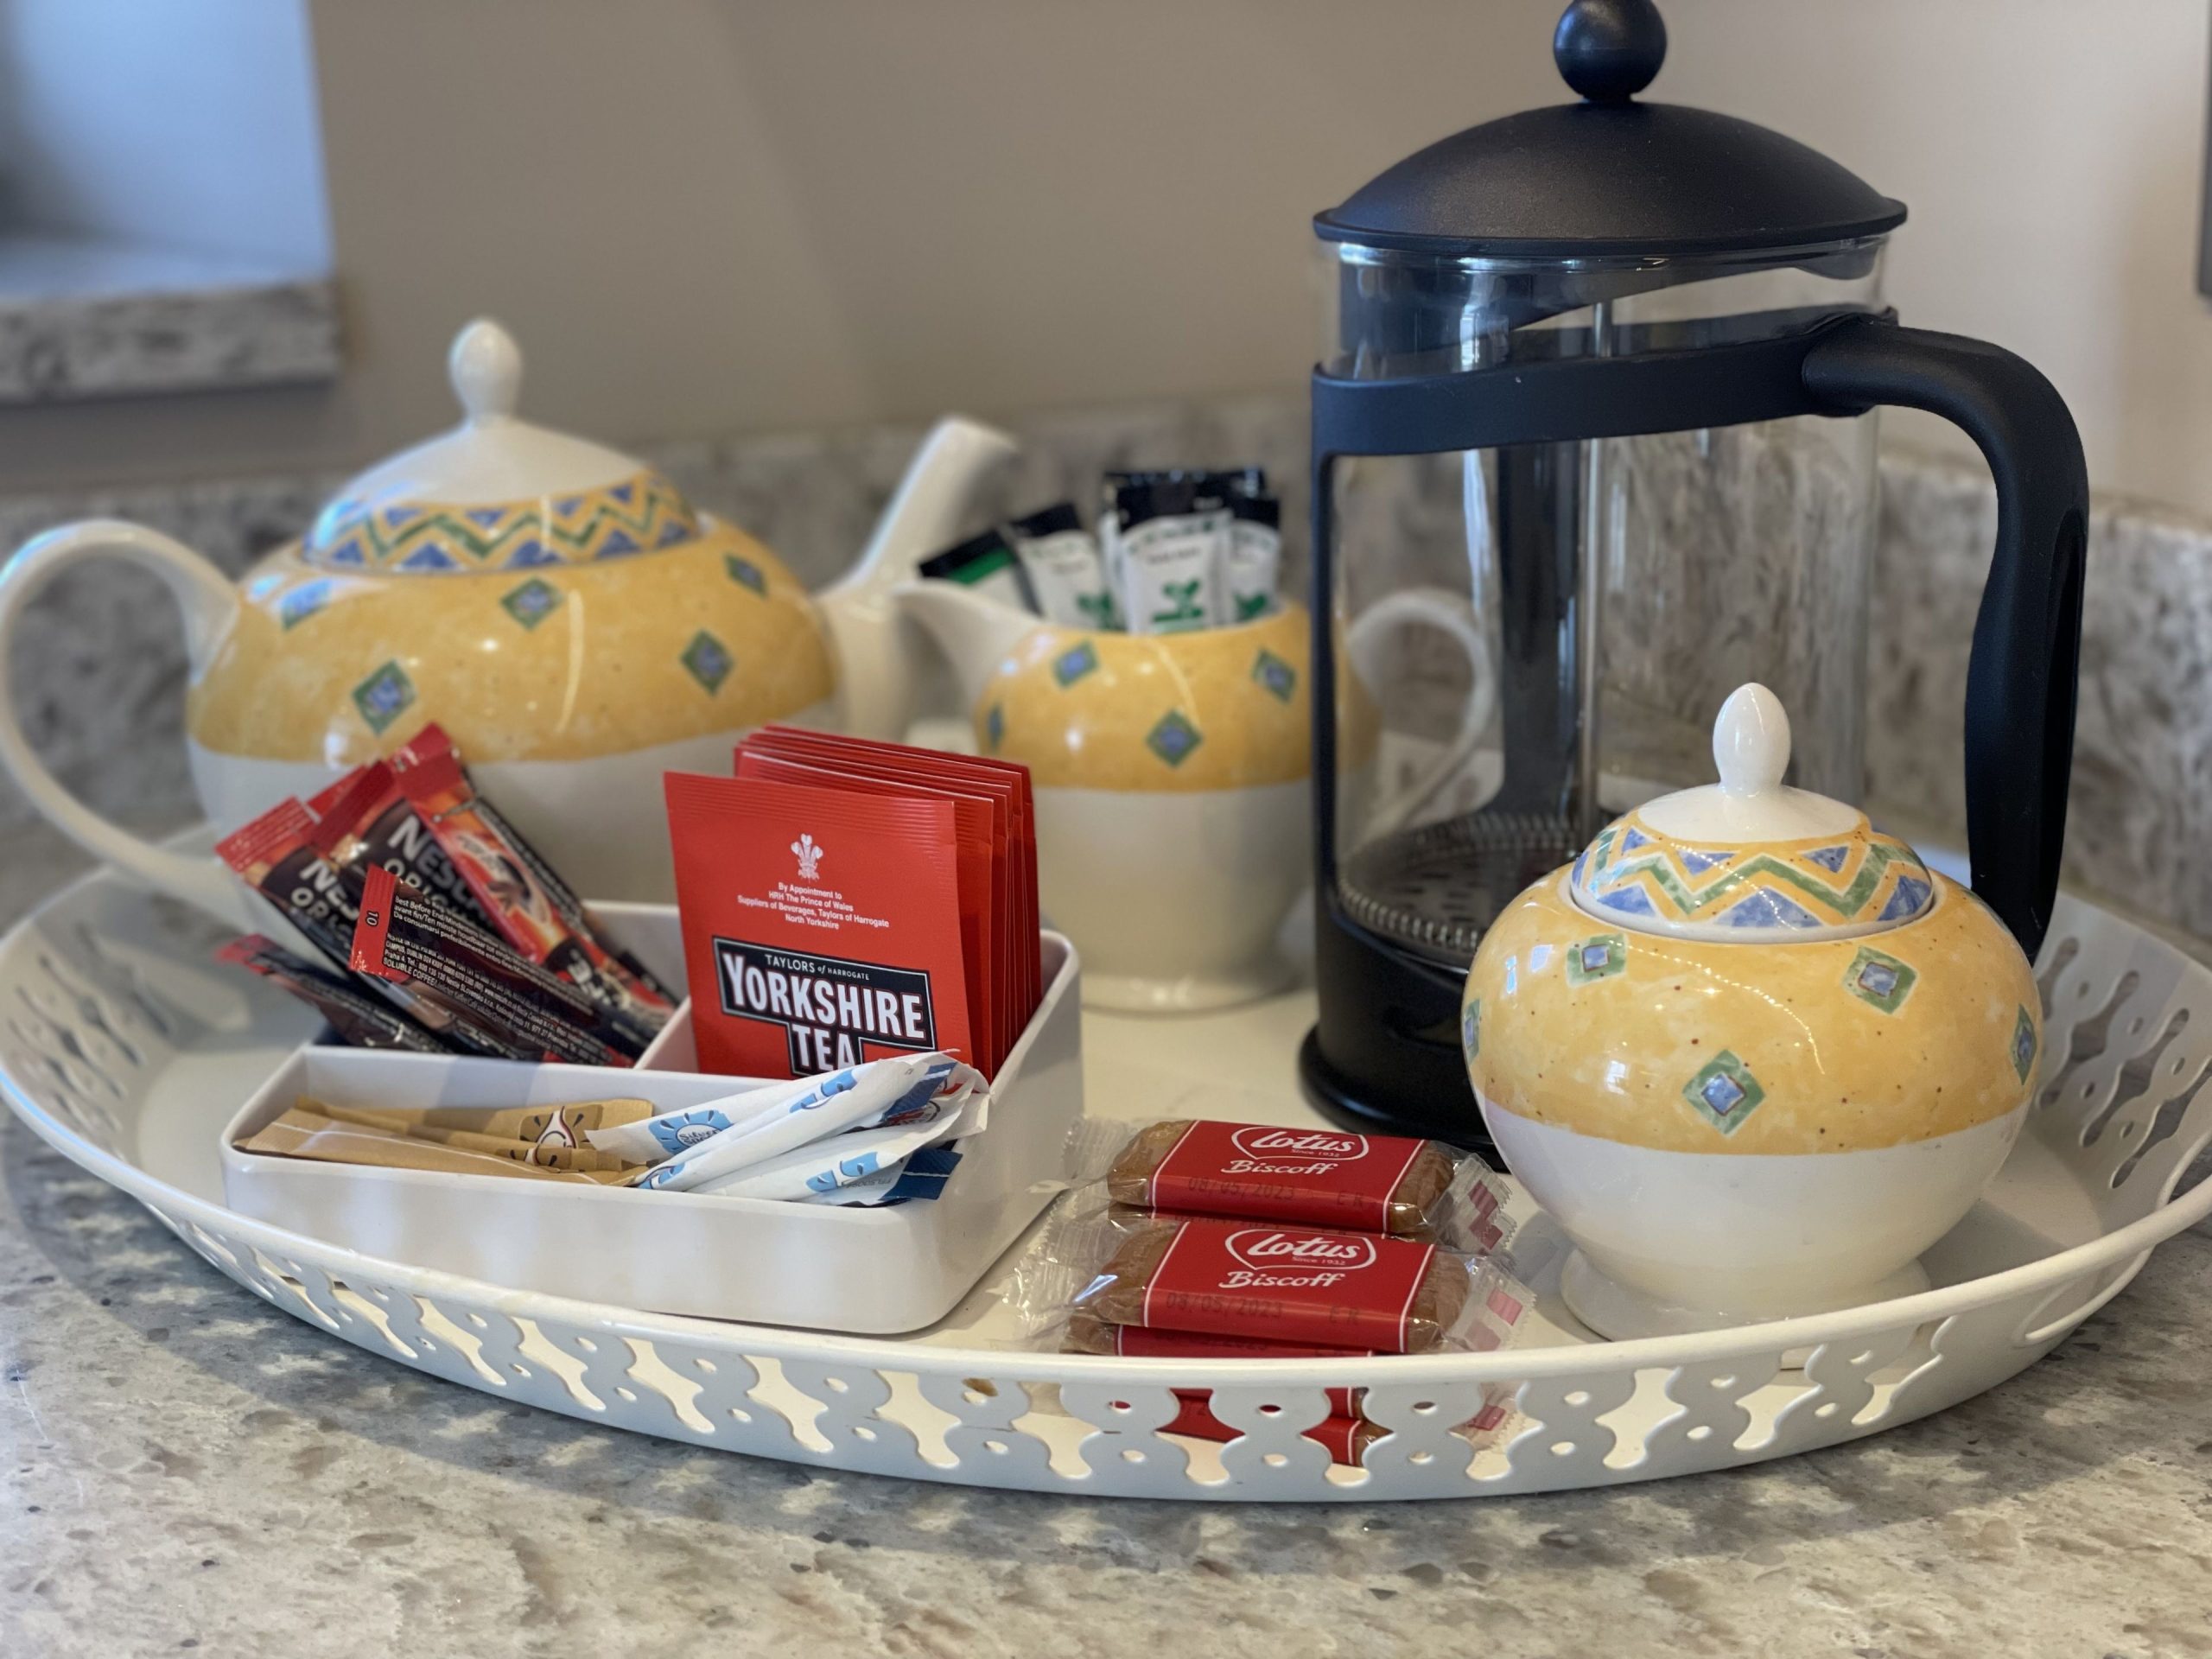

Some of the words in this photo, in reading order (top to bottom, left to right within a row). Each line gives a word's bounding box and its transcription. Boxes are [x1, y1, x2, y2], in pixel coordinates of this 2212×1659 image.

[779, 881, 788, 893] By
[789, 884, 834, 899] Appointment
[835, 892, 842, 900] to
[395, 895, 410, 907] Best
[410, 899, 431, 913] Before
[768, 890, 785, 900] HRH
[785, 893, 799, 904] The
[800, 895, 823, 906] Prince
[823, 899, 832, 908] of
[832, 901, 854, 912] Wales
[393, 906, 413, 917] avant
[737, 895, 769, 908] Suppliers
[770, 901, 778, 910] of
[818, 908, 844, 921] Taylors
[845, 912, 854, 922] of
[854, 914, 890, 929] Harrogate
[393, 911, 403, 920] Da
[404, 916, 440, 935] consumarsi
[785, 913, 804, 925] North
[806, 917, 840, 931] Yorkshire
[385, 949, 400, 962] Praha
[383, 957, 413, 975] SOLUBLE
[765, 953, 815, 974] TAYLORS
[817, 964, 827, 975] of
[827, 967, 870, 982] HARROGATE
[721, 952, 925, 1039] YORKSHIRE
[791, 1022, 856, 1071] TEA
[1250, 1131, 1356, 1152] Lotus
[1220, 1160, 1338, 1175] Biscoff
[1247, 1233, 1361, 1260] Lotus
[1218, 1270, 1346, 1289] Biscoff
